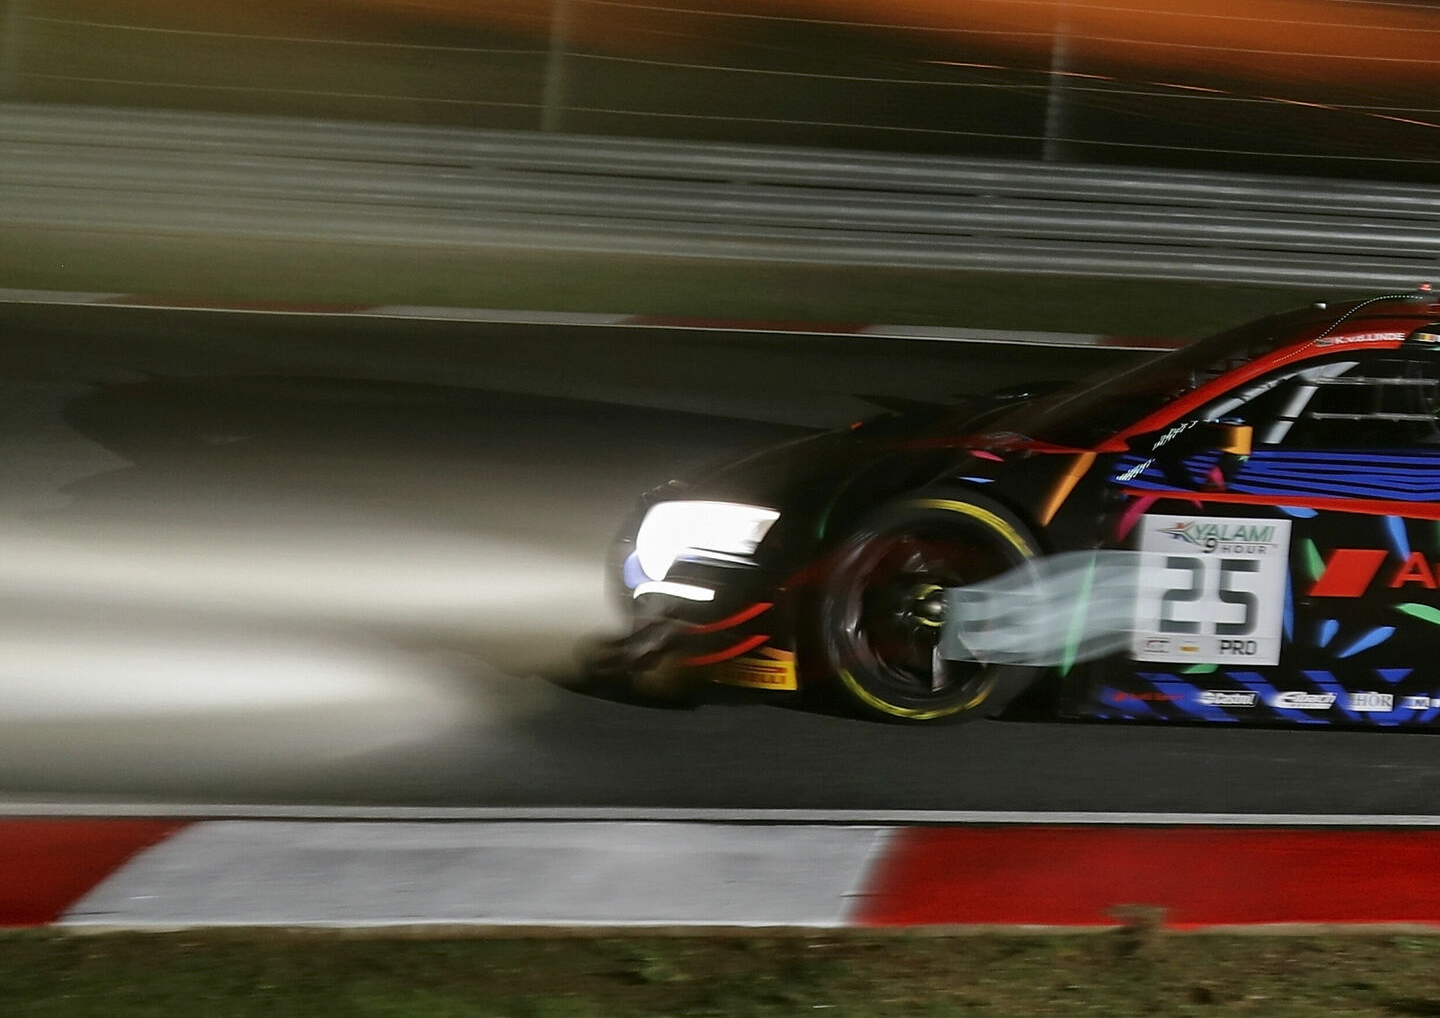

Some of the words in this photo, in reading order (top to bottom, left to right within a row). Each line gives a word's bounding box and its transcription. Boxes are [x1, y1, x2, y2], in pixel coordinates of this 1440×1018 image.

[1200, 537, 1218, 554] 9
[1221, 545, 1268, 556] HOUR
[1160, 556, 1260, 636] 25
[1218, 639, 1258, 656] PRO
